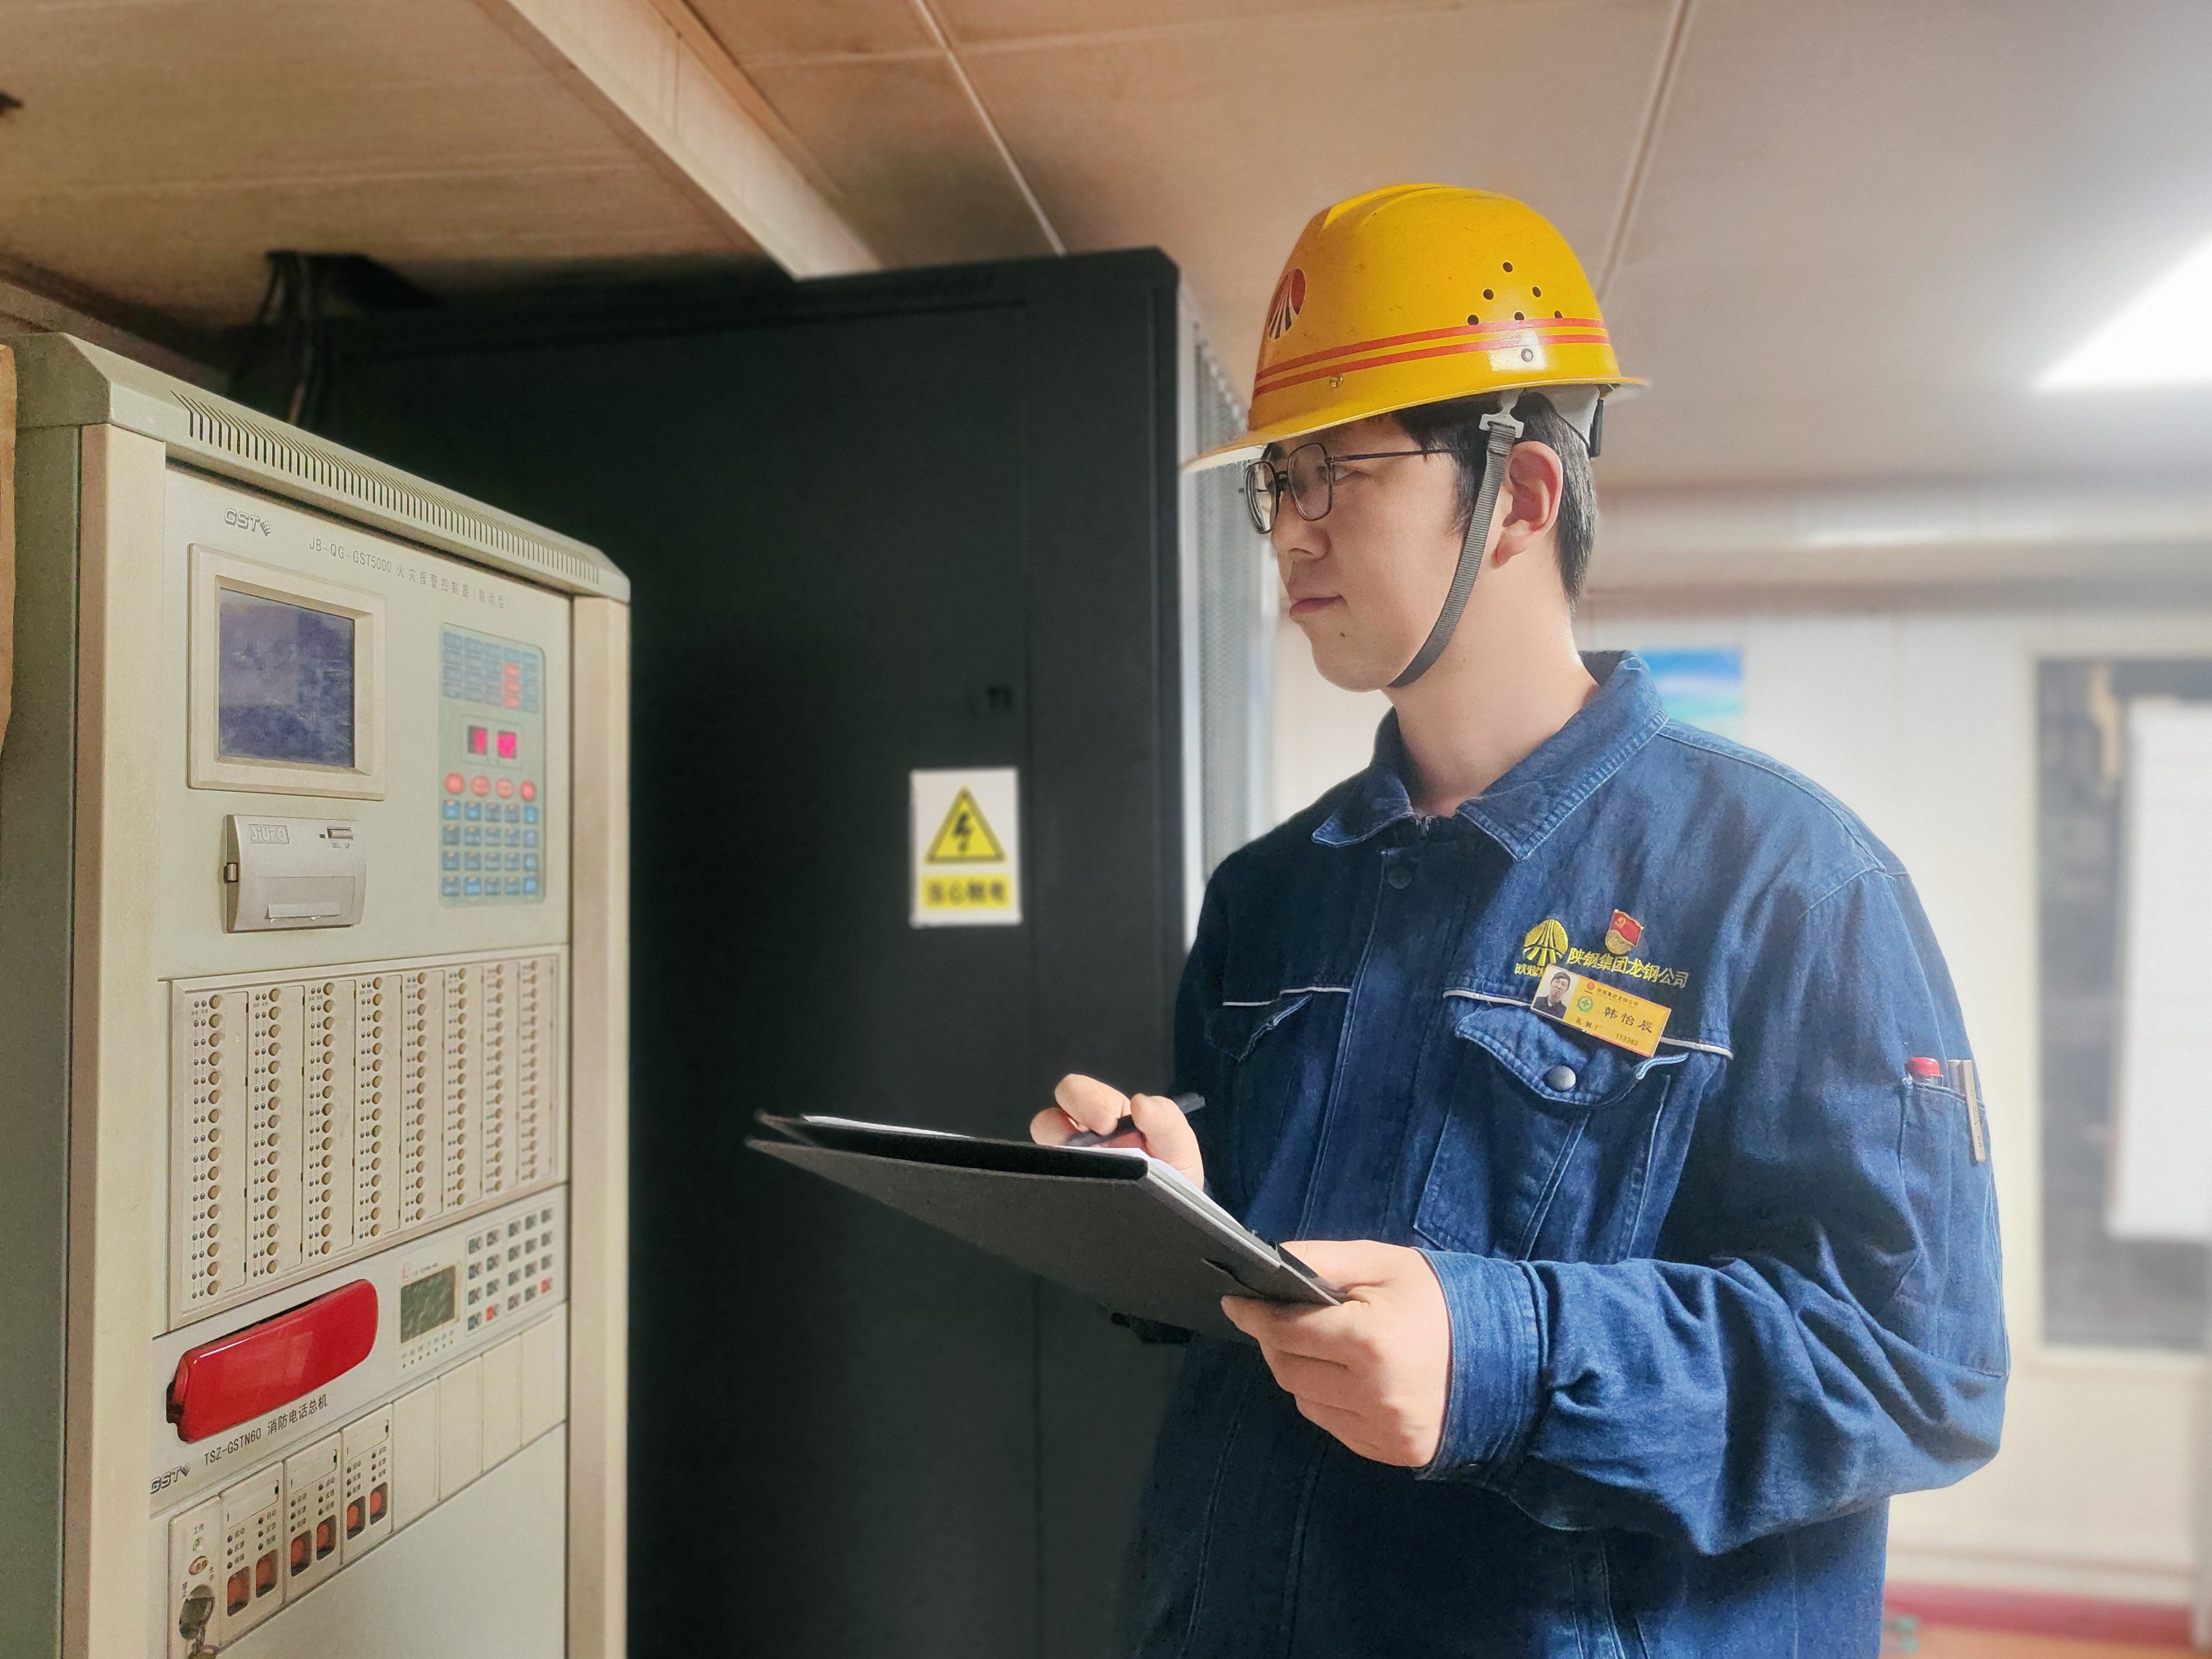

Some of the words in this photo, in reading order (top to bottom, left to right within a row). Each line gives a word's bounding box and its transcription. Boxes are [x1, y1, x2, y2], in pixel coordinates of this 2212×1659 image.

[224, 508, 261, 532] GST
[309, 537, 391, 573] JB-QG-GST5000
[1566, 947, 1689, 989] 陕钢集团龙钢公司
[1603, 1006, 1653, 1033] 韩怡辰
[1616, 1033, 1639, 1047] 113382
[204, 1427, 261, 1466] TSZ-GSTN60
[267, 1393, 327, 1436] 消防电话总机
[150, 1466, 183, 1494] GST
